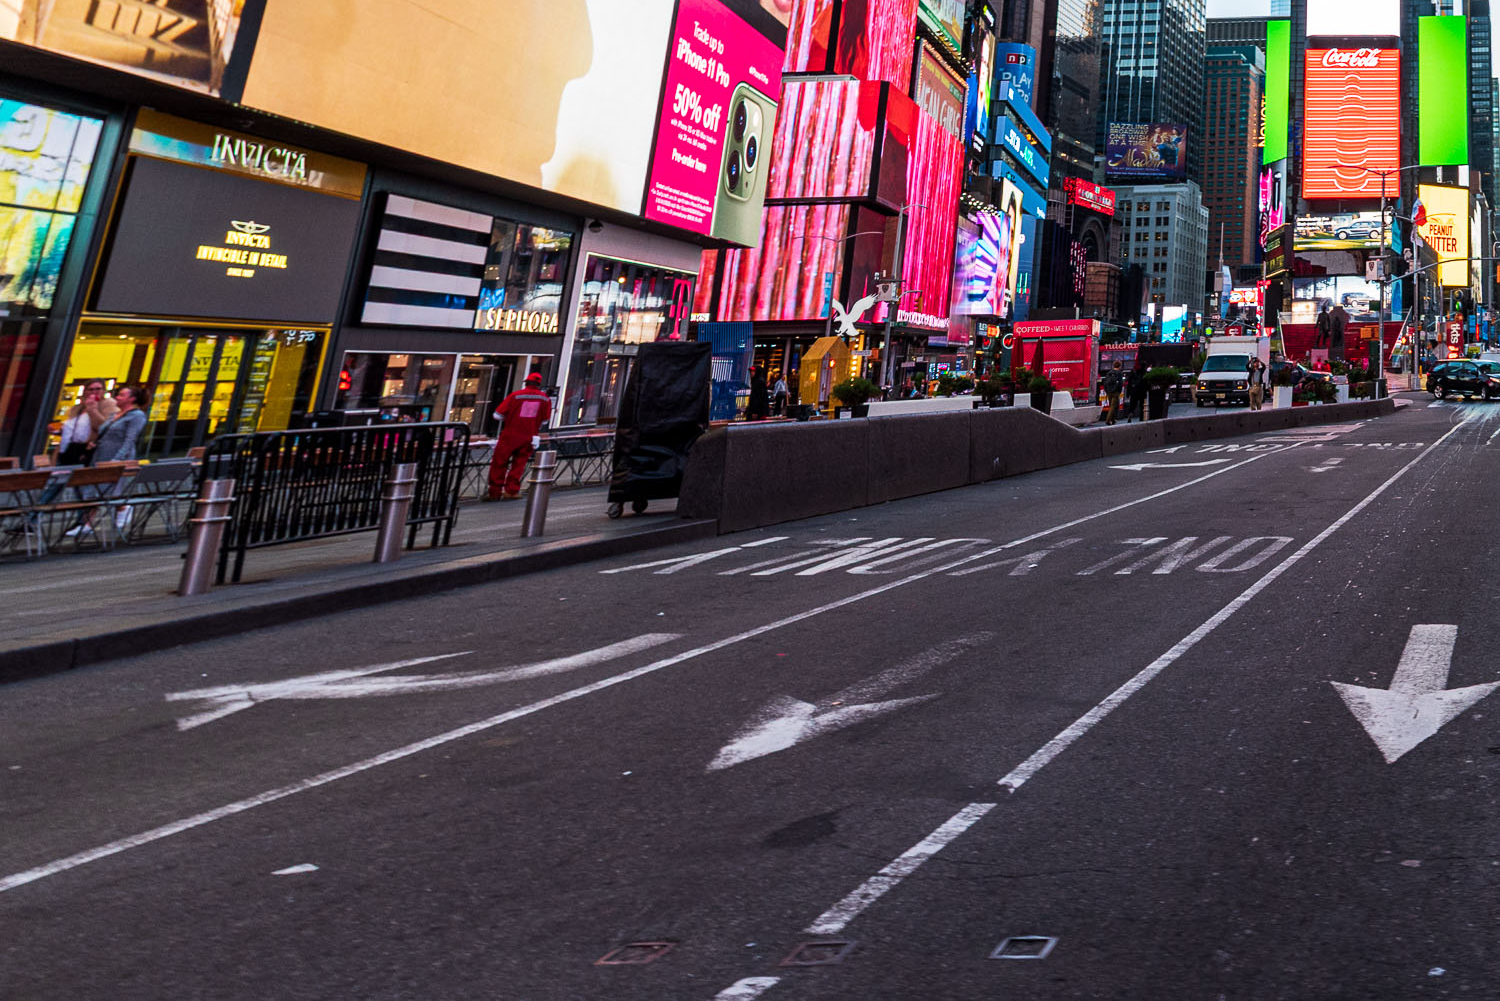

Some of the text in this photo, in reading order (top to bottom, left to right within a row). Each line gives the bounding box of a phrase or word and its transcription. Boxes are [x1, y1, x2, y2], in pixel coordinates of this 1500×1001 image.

[693, 20, 724, 55] Trade up to
[676, 37, 707, 74] iPhone
[706, 57, 717, 80] 11
[715, 62, 730, 88] Pro
[1322, 48, 1382, 68] Coca-Cola
[672, 82, 703, 124] 50%
[702, 103, 722, 133] off
[209, 133, 308, 180] INVICTA
[671, 147, 695, 168] Pre-order
[225, 230, 271, 249] INVICTA
[1429, 224, 1453, 237] PEANUT
[1424, 236, 1457, 253] BUTTER
[247, 251, 260, 266] IN
[485, 307, 559, 334] SEPHORA
[1016, 325, 1050, 335] COFFEED
[1450, 322, 1459, 345] tkts
